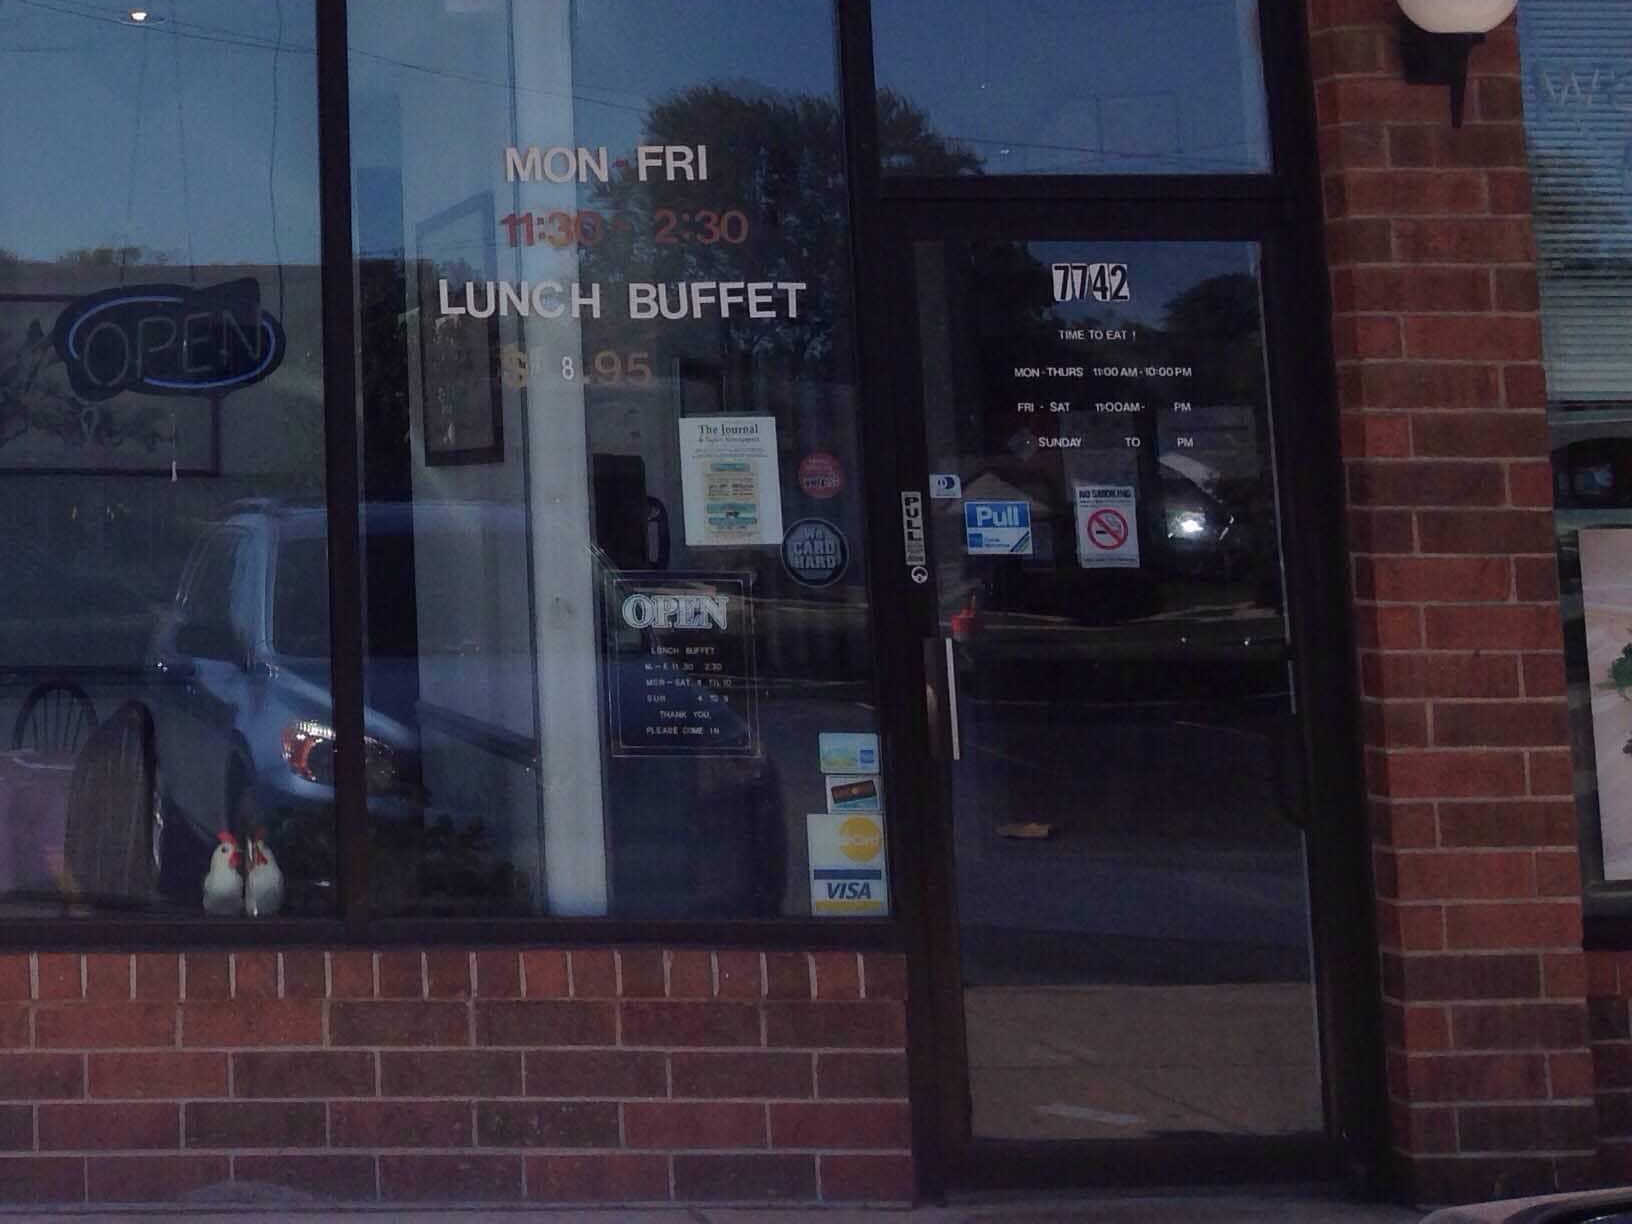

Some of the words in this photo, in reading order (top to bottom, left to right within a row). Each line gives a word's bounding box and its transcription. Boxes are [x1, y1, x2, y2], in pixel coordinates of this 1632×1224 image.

[504, 145, 609, 183] MON
[636, 144, 709, 182] FRI
[501, 210, 604, 248] 11:30
[654, 208, 749, 246] 2:30
[1054, 264, 1129, 301] 7742
[439, 279, 601, 319] LUNCH
[629, 281, 807, 320] BUFFET
[1058, 330, 1085, 341] TIME
[1089, 330, 1103, 341] TO
[83, 310, 264, 387] OPEN
[1017, 402, 1034, 413] FRI
[1049, 402, 1071, 413] SAT
[1174, 402, 1191, 412] PM
[698, 423, 718, 435] The
[721, 423, 759, 436] Journal
[1038, 437, 1082, 448] SUNDAY
[1125, 437, 1141, 448] TO
[1177, 437, 1194, 448] PM
[904, 496, 922, 541] PULL
[976, 506, 1019, 527] Pull
[793, 539, 835, 555] CARD
[622, 593, 729, 630] OPEN
[659, 710, 687, 719] THANK
[646, 726, 679, 735] PLEASE
[682, 726, 705, 735] COME
[826, 882, 872, 900] VISA
